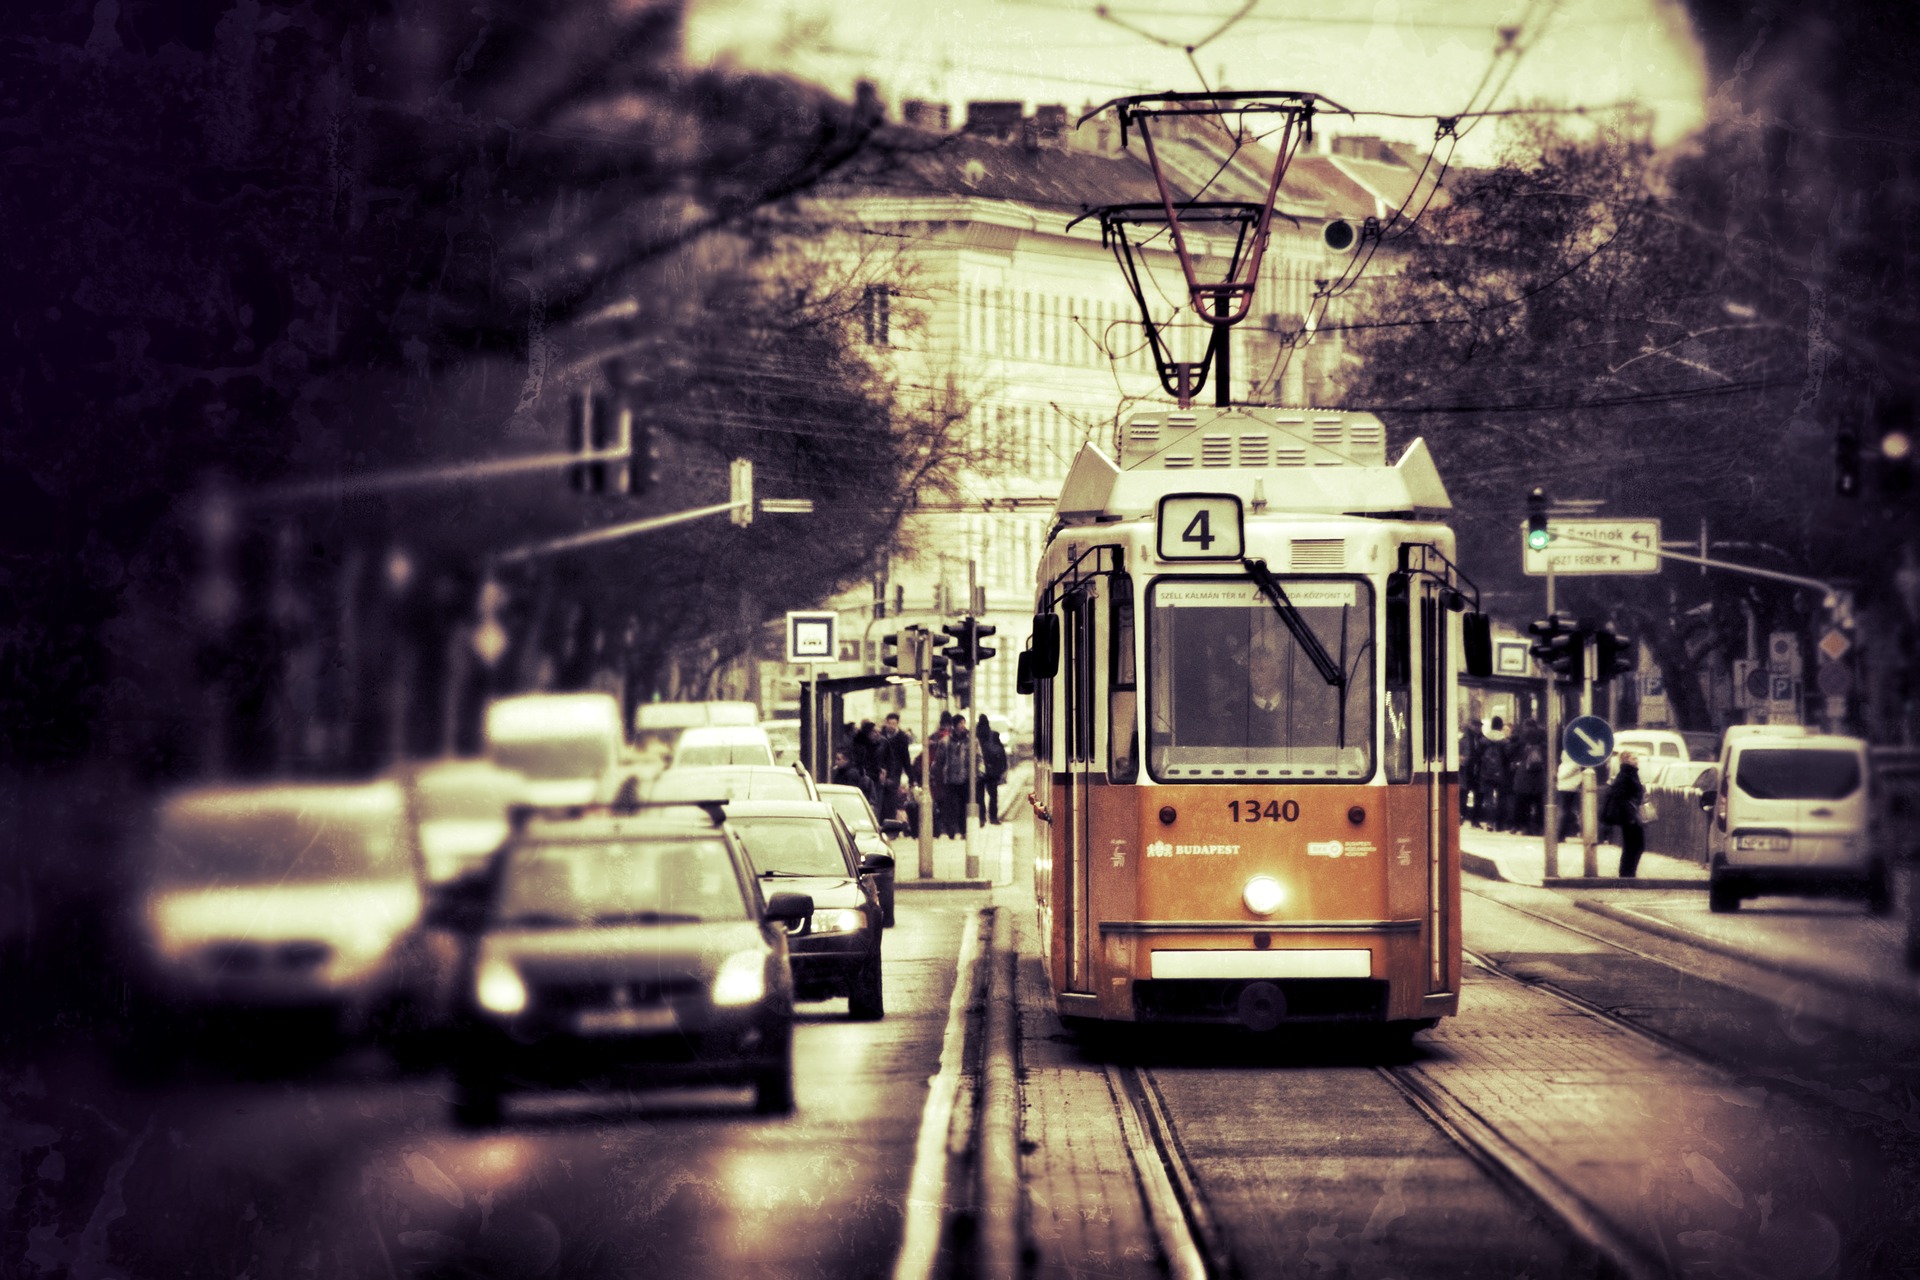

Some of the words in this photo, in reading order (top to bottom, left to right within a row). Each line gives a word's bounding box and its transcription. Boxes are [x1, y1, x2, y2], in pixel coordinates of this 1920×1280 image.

[1181, 509, 1215, 550] 4
[1238, 592, 1246, 600] M
[1228, 800, 1300, 823] 1340
[1175, 844, 1241, 855] BUDAPEST
